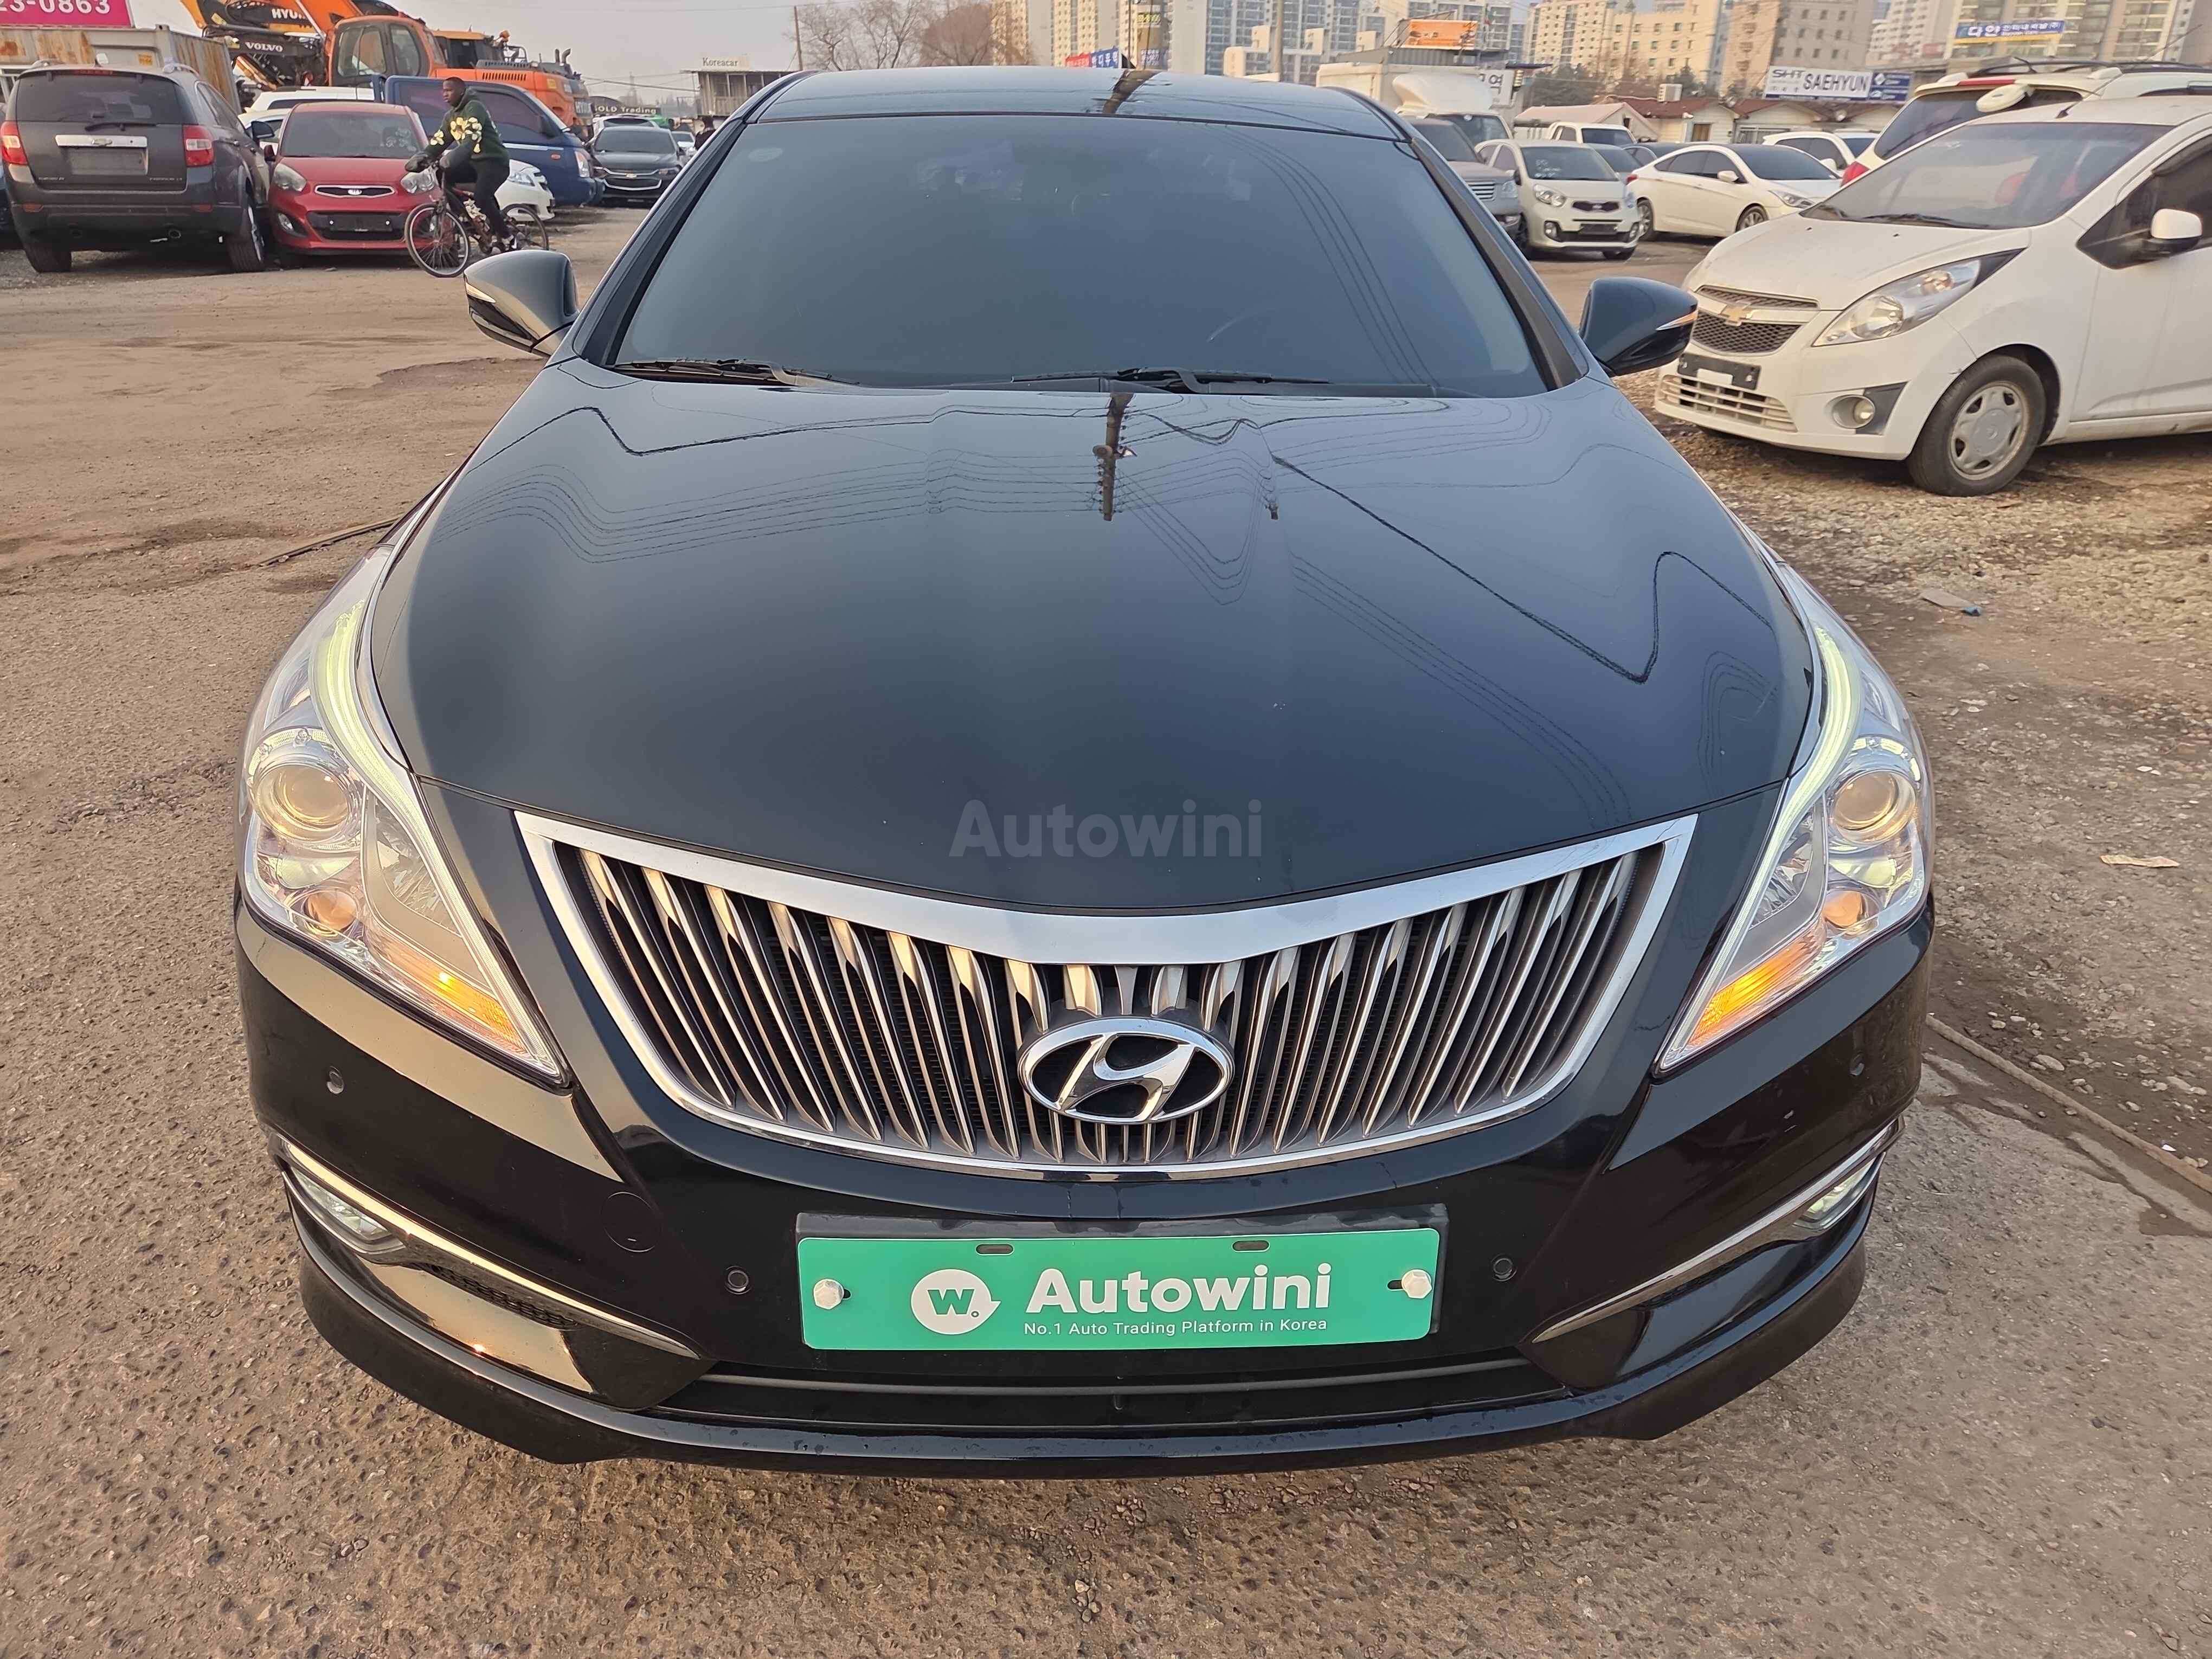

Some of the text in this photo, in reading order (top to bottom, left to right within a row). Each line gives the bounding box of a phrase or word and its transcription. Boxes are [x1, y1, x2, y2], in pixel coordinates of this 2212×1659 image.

[245, 42, 284, 52] VOLVO
[703, 57, 738, 66] Koreacar
[1803, 73, 1868, 92] SAEHYUN
[1025, 1262, 1332, 1313] Autowini
[1024, 1318, 1327, 1336] No.1 Auto Trading Platform in Korea
